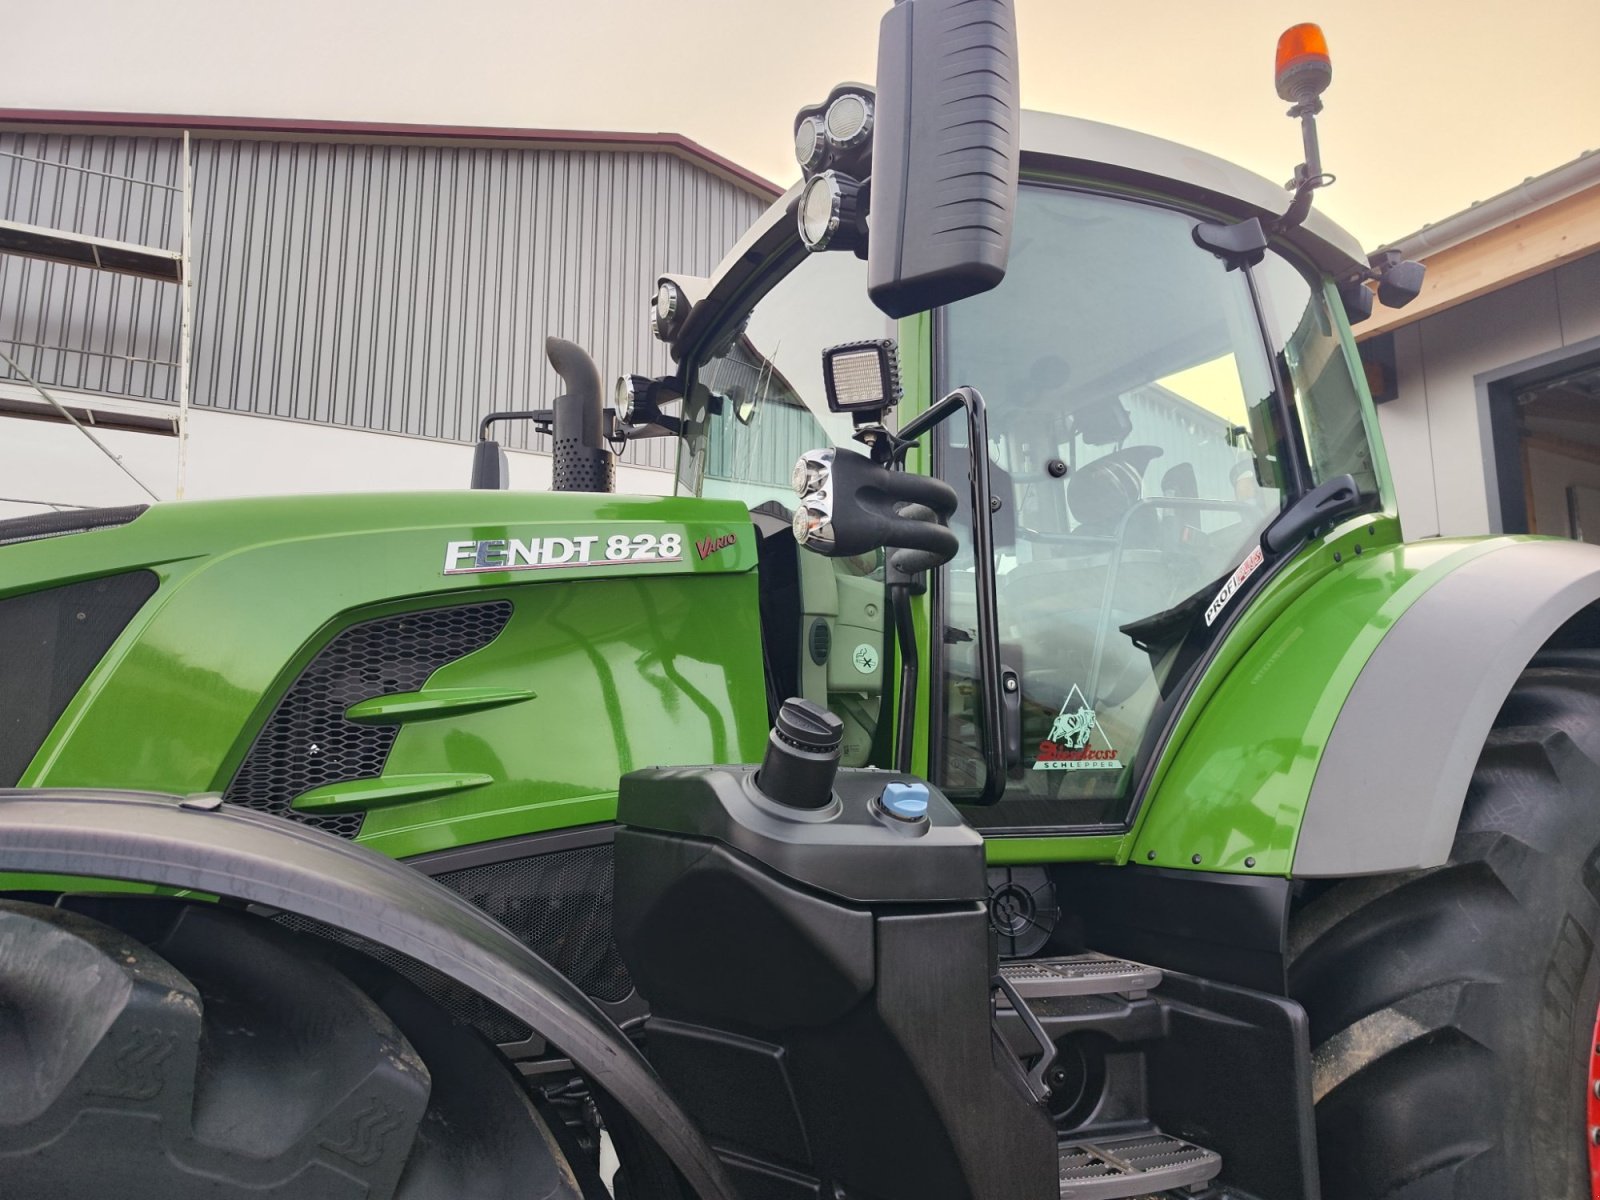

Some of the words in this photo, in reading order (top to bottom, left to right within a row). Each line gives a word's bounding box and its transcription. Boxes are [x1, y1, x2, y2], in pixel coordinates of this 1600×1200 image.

[444, 536, 599, 570] FENDT
[605, 533, 683, 561] 828
[1206, 577, 1238, 622] PROFI
[1044, 761, 1114, 769] SCHLEPPER
